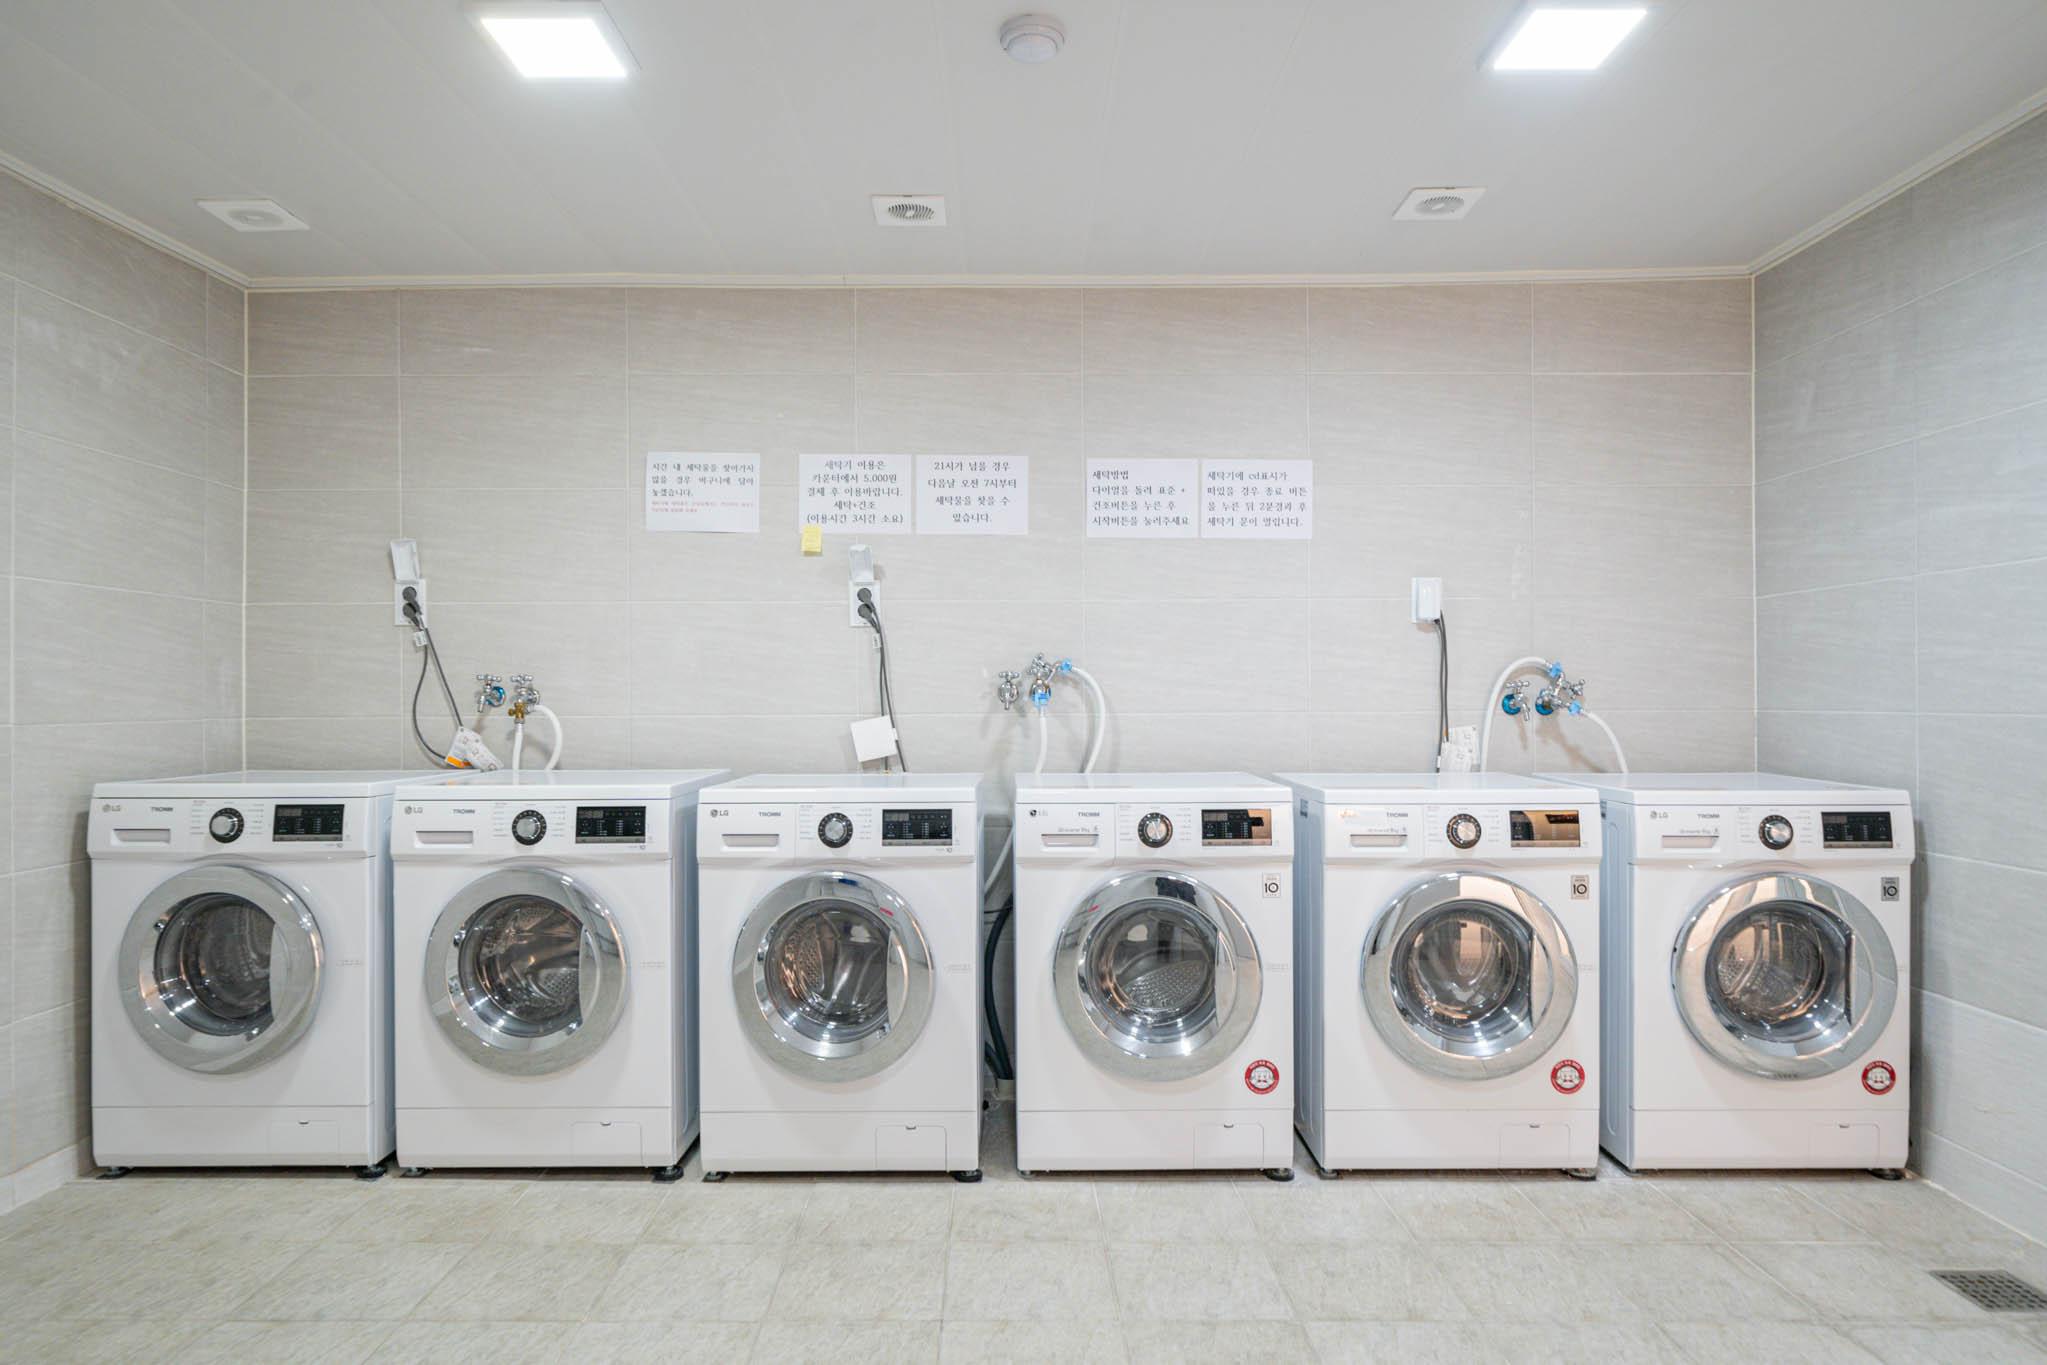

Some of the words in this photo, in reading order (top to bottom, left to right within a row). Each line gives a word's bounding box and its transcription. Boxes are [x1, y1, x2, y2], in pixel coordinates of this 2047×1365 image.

[687, 463, 717, 473] 세탁물을
[824, 460, 852, 470] 세탁기
[857, 460, 886, 470] 이용은
[933, 461, 964, 472] 21시가
[968, 461, 987, 472] 넘을
[992, 461, 1010, 472] 경우
[812, 474, 859, 484] 카운터에서
[1092, 470, 1129, 480] 세탁방법
[1207, 472, 1244, 481] 세탁기에
[927, 479, 956, 489] 다음날
[961, 479, 979, 489] 오전
[983, 479, 1017, 489] 7시부터
[807, 487, 825, 497] 결제
[831, 487, 840, 497] 후
[1092, 485, 1128, 496] 다이얼을
[1135, 485, 1152, 496] 돌려
[1158, 485, 1176, 496] 표준
[1240, 486, 1259, 497] 경우
[1264, 486, 1283, 497] 종료
[1288, 486, 1309, 497] 버튼
[935, 496, 972, 506] 세탁물을
[977, 496, 995, 506] 찾을
[999, 496, 1010, 506] 수
[1093, 501, 1138, 511] 건조버튼을
[1143, 501, 1162, 511] 누른
[1167, 501, 1176, 511] 후
[1207, 502, 1217, 512] 을
[1221, 502, 1240, 512] 누른
[1245, 502, 1255, 512] 뒤
[1298, 502, 1307, 512] 후
[806, 514, 847, 524] (이용시간
[851, 514, 876, 524] 3시간
[880, 514, 904, 524] 소요)
[951, 513, 993, 523] 있습니다.
[1092, 516, 1138, 527] 시작버튼을
[1207, 517, 1235, 527] 세탁기
[1239, 517, 1258, 527] 문이
[1262, 517, 1304, 527] 열립니다.
